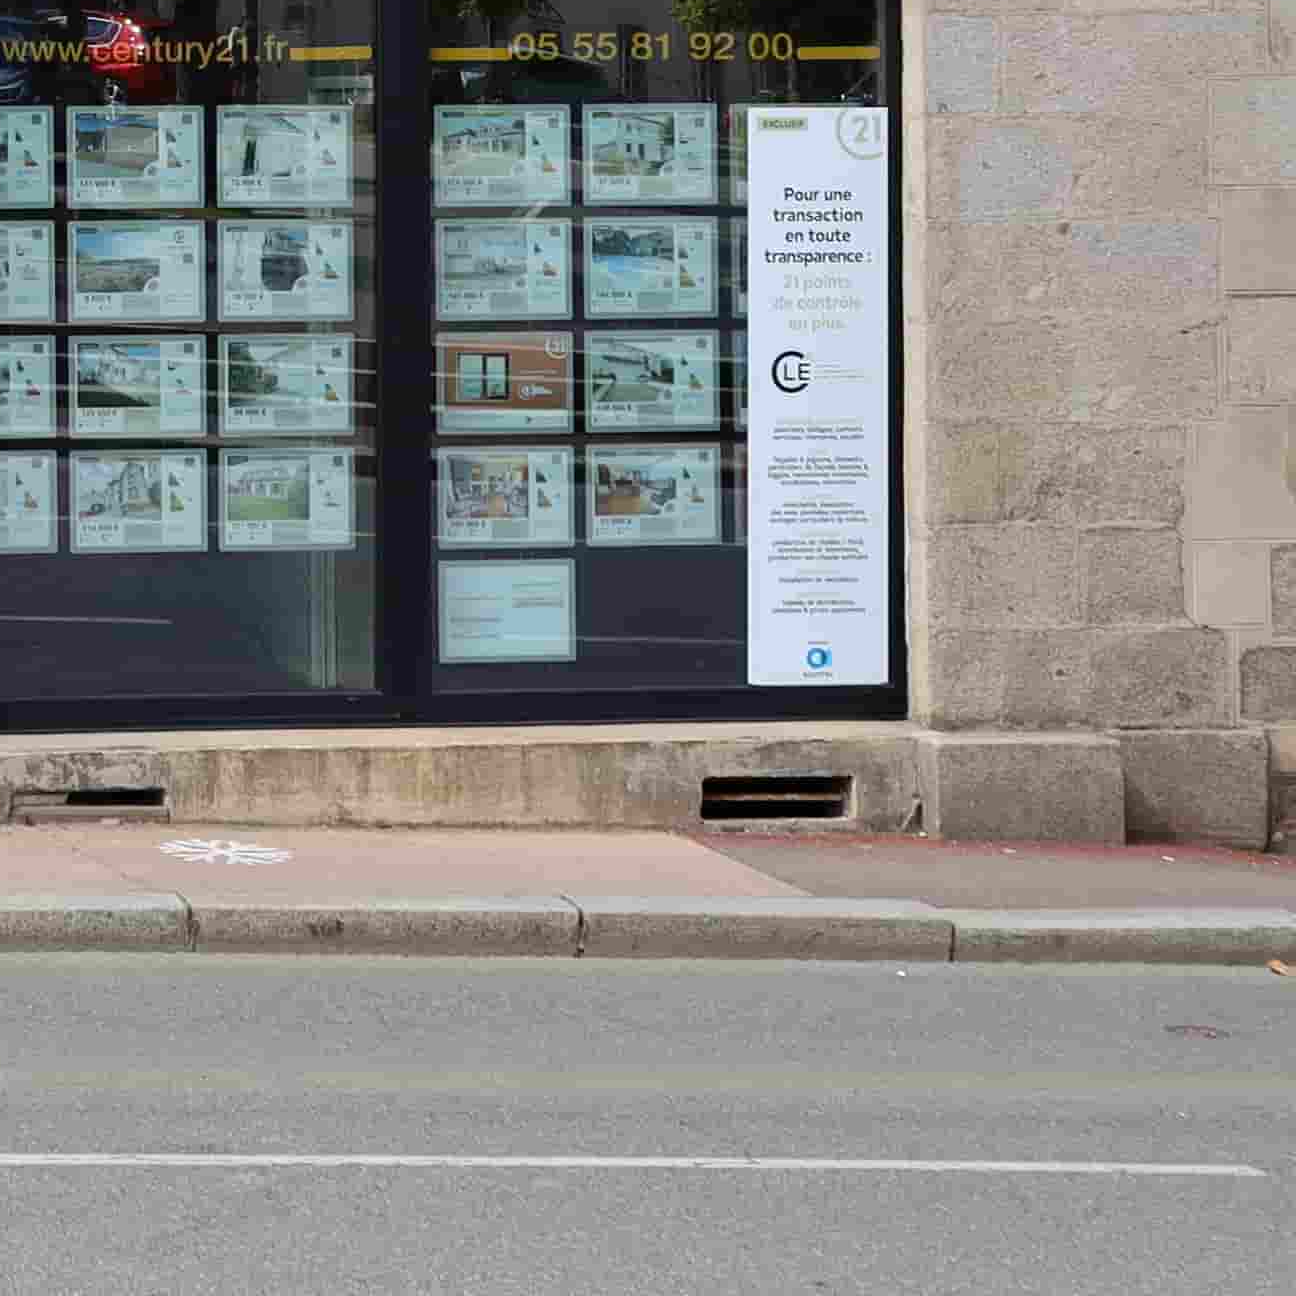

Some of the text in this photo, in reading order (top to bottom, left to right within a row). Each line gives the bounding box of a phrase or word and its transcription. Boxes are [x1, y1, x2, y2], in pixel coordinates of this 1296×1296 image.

[1, 32, 289, 70] www.century21.fr
[512, 32, 793, 61] 05 55 81 92 00
[784, 187, 852, 202] Pour une
[773, 206, 863, 223] transaction
[785, 228, 851, 243] en toute
[764, 250, 863, 267] transparence
